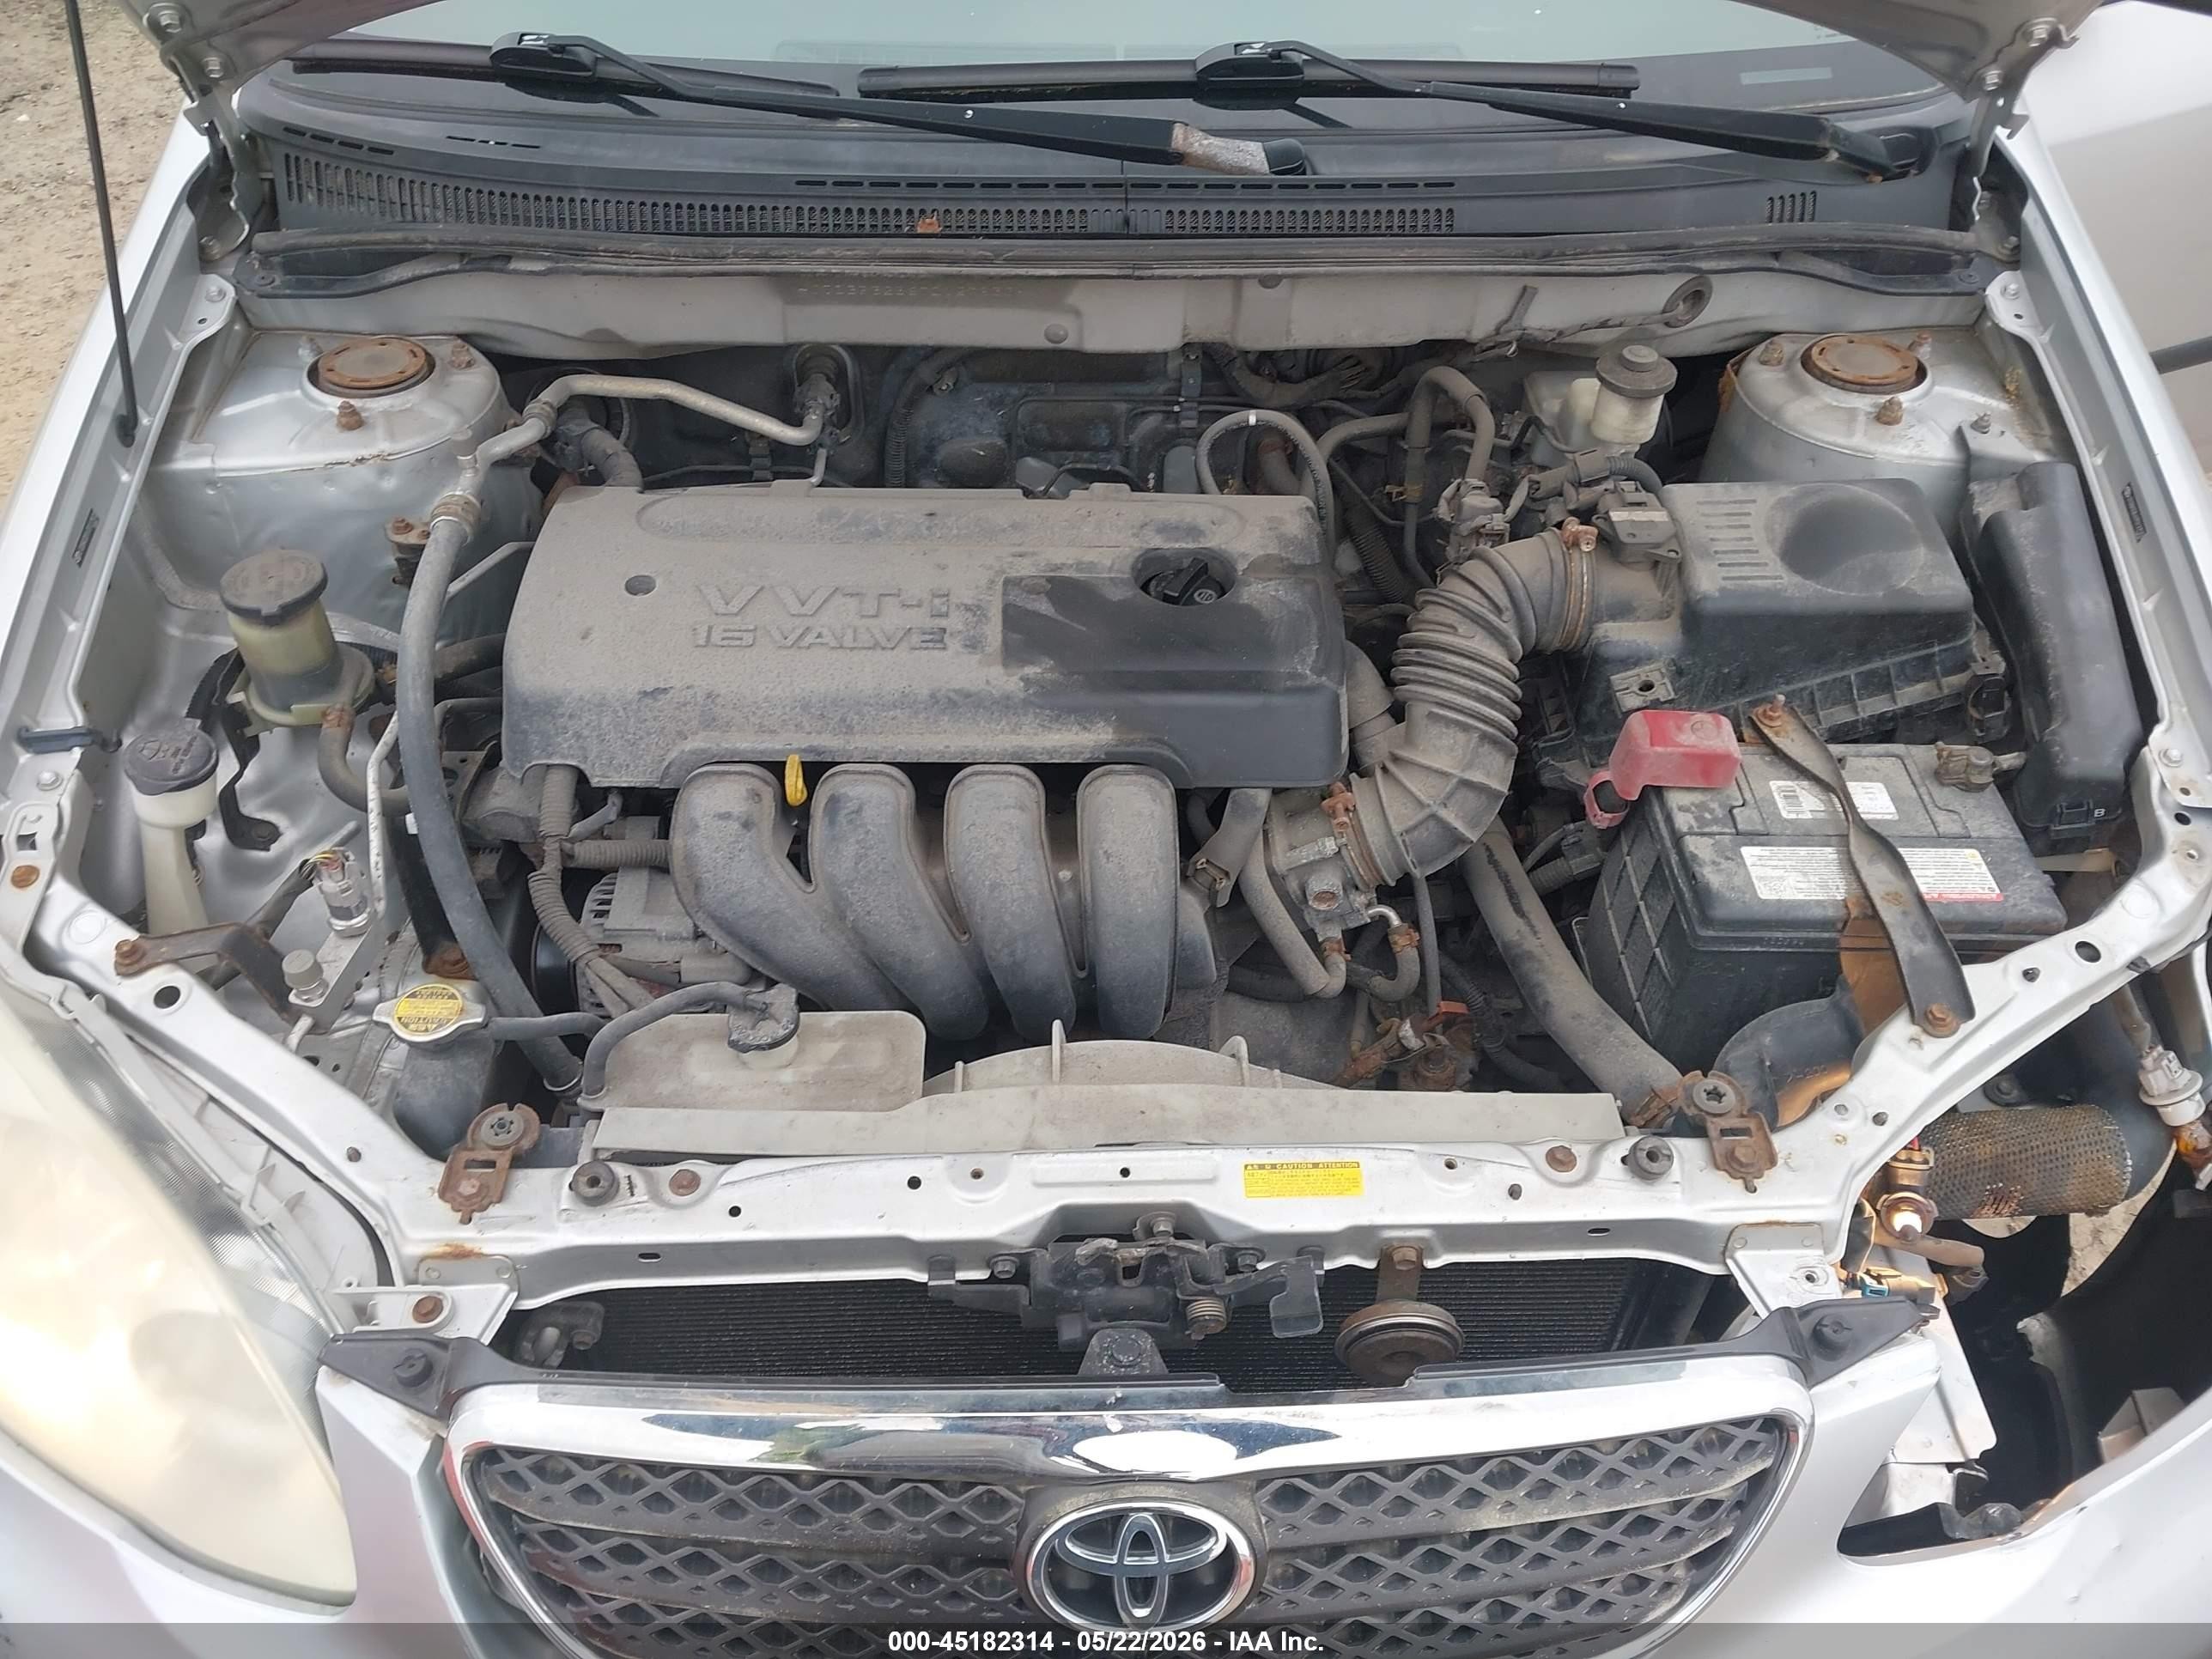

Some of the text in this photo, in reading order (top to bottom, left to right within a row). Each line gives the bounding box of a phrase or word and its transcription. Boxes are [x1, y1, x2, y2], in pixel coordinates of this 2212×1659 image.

[696, 584, 950, 618] VVT-i
[691, 624, 948, 651] 16 VALVE
[2094, 808, 2106, 817] B
